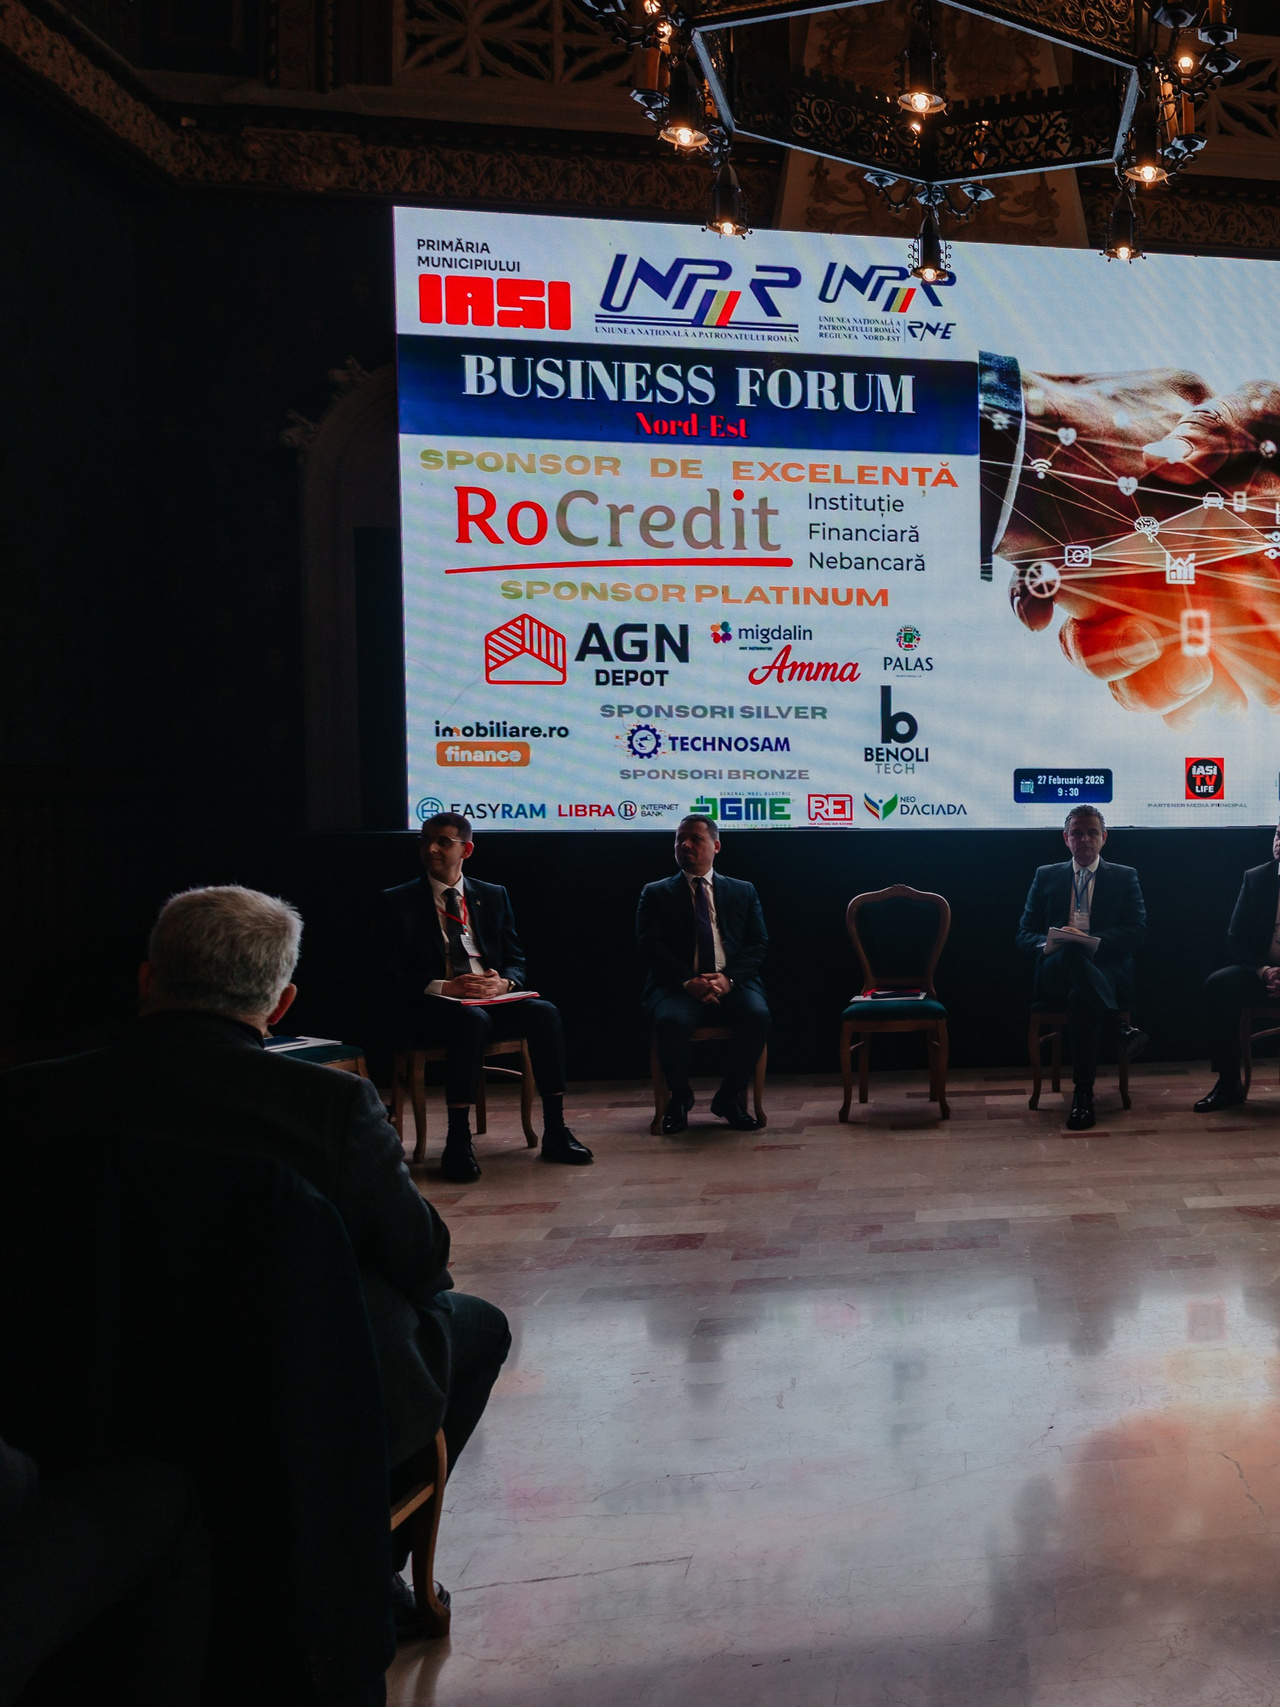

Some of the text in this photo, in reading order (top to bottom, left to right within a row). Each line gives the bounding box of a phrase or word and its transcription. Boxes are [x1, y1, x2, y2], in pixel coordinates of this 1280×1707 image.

[417, 238, 490, 254] PRIMĂRIA
[417, 256, 520, 272] MUNICIPIULUI
[819, 316, 850, 324] UNIUNEA
[595, 326, 635, 335] UNIUNEA
[698, 332, 765, 342] PATRONATULUI
[819, 332, 859, 340] REGIUNEA
[461, 354, 917, 416] BUSINESS FORUM
[419, 448, 622, 479] SPONSOR
[650, 458, 704, 480] DE
[807, 492, 906, 518] Instituție
[454, 486, 782, 551] RoCredit
[808, 522, 921, 544] Financiară
[808, 550, 926, 573] Nebancară
[500, 580, 890, 607] SPONSOR PLATINUM
[738, 624, 814, 644] migdalin
[574, 622, 690, 664] AGN
[748, 644, 862, 686] Amma
[882, 656, 934, 672] PALAS
[594, 668, 670, 687] DEPOT
[600, 704, 828, 720] SPONSORI SILVER
[434, 720, 570, 738] imobiliare.ro
[668, 736, 791, 752] TECHNOSAM
[444, 746, 522, 763] finance
[864, 747, 929, 762] BENOLI
[620, 768, 810, 780] SPONSORI BRONZE
[874, 762, 916, 774] TECH
[1037, 775, 1105, 784] 27 Februarie 2026
[1192, 774, 1218, 786] TV
[451, 803, 547, 819] EASYRAM
[558, 804, 616, 818] LIBRA
[640, 803, 679, 811] INTERNET
[720, 798, 792, 820] GME
